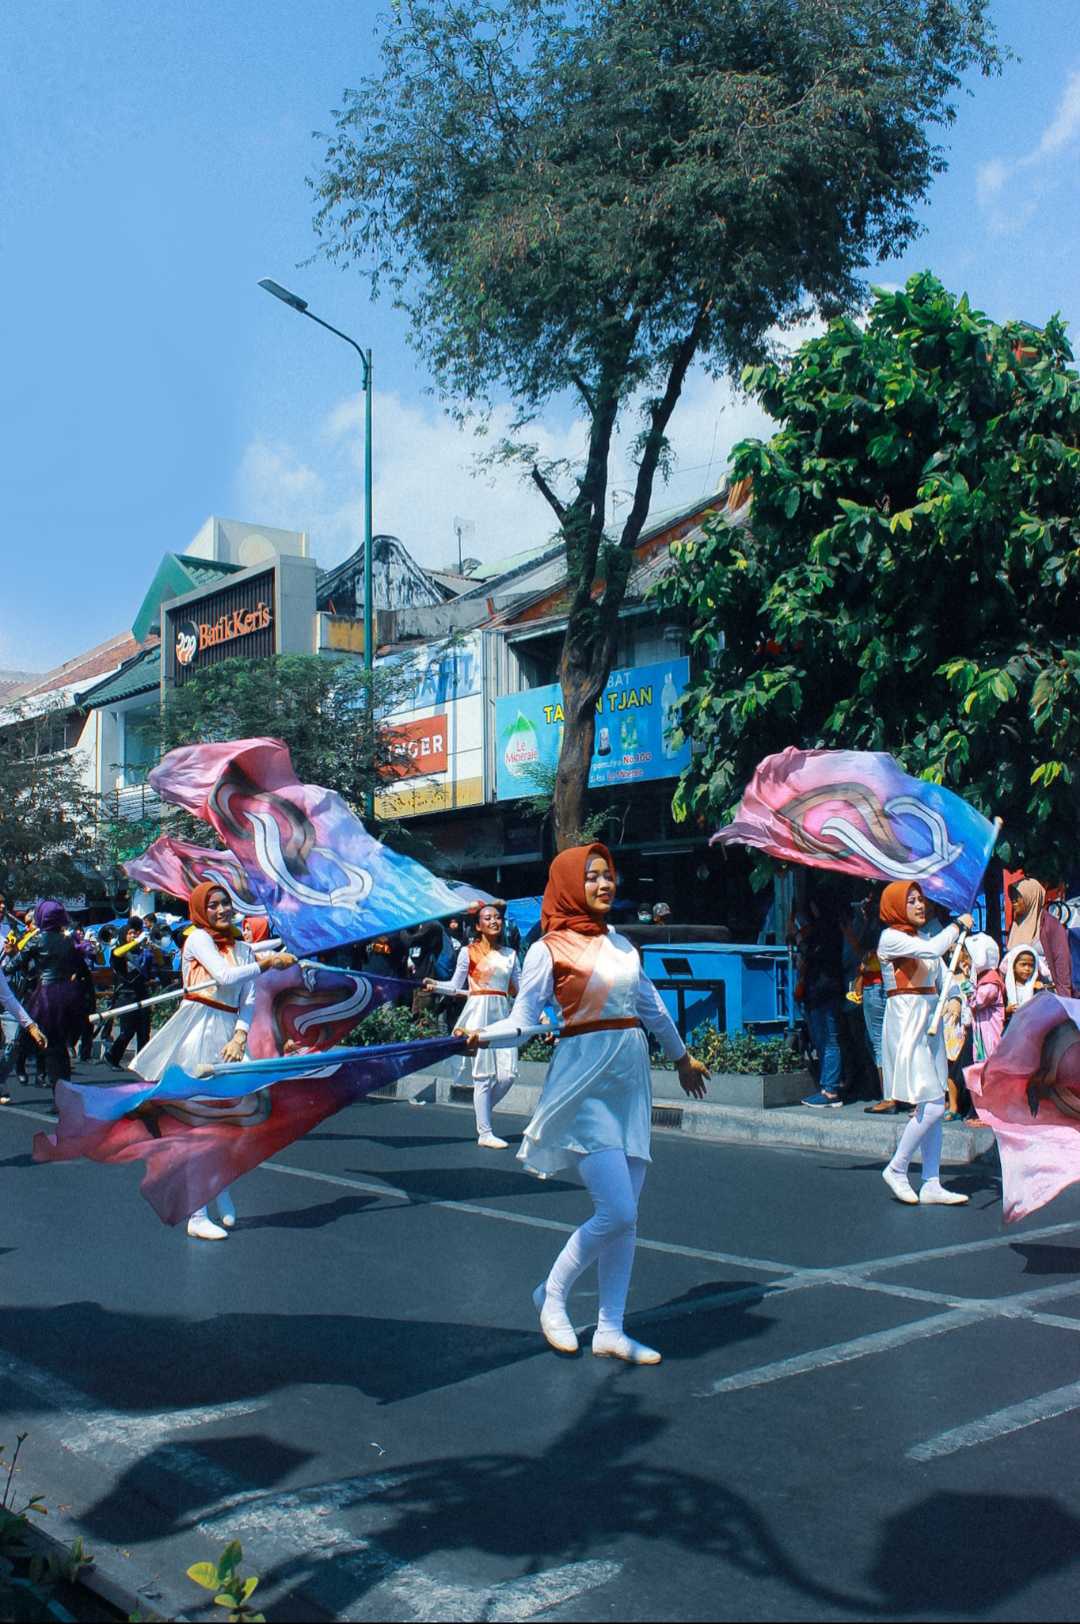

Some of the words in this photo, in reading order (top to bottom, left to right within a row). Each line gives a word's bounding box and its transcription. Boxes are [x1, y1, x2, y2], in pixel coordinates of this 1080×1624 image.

[199, 615, 233, 651] Batik
[233, 602, 271, 636] Keris
[606, 672, 631, 688] BAT
[607, 685, 653, 712] TJAN
